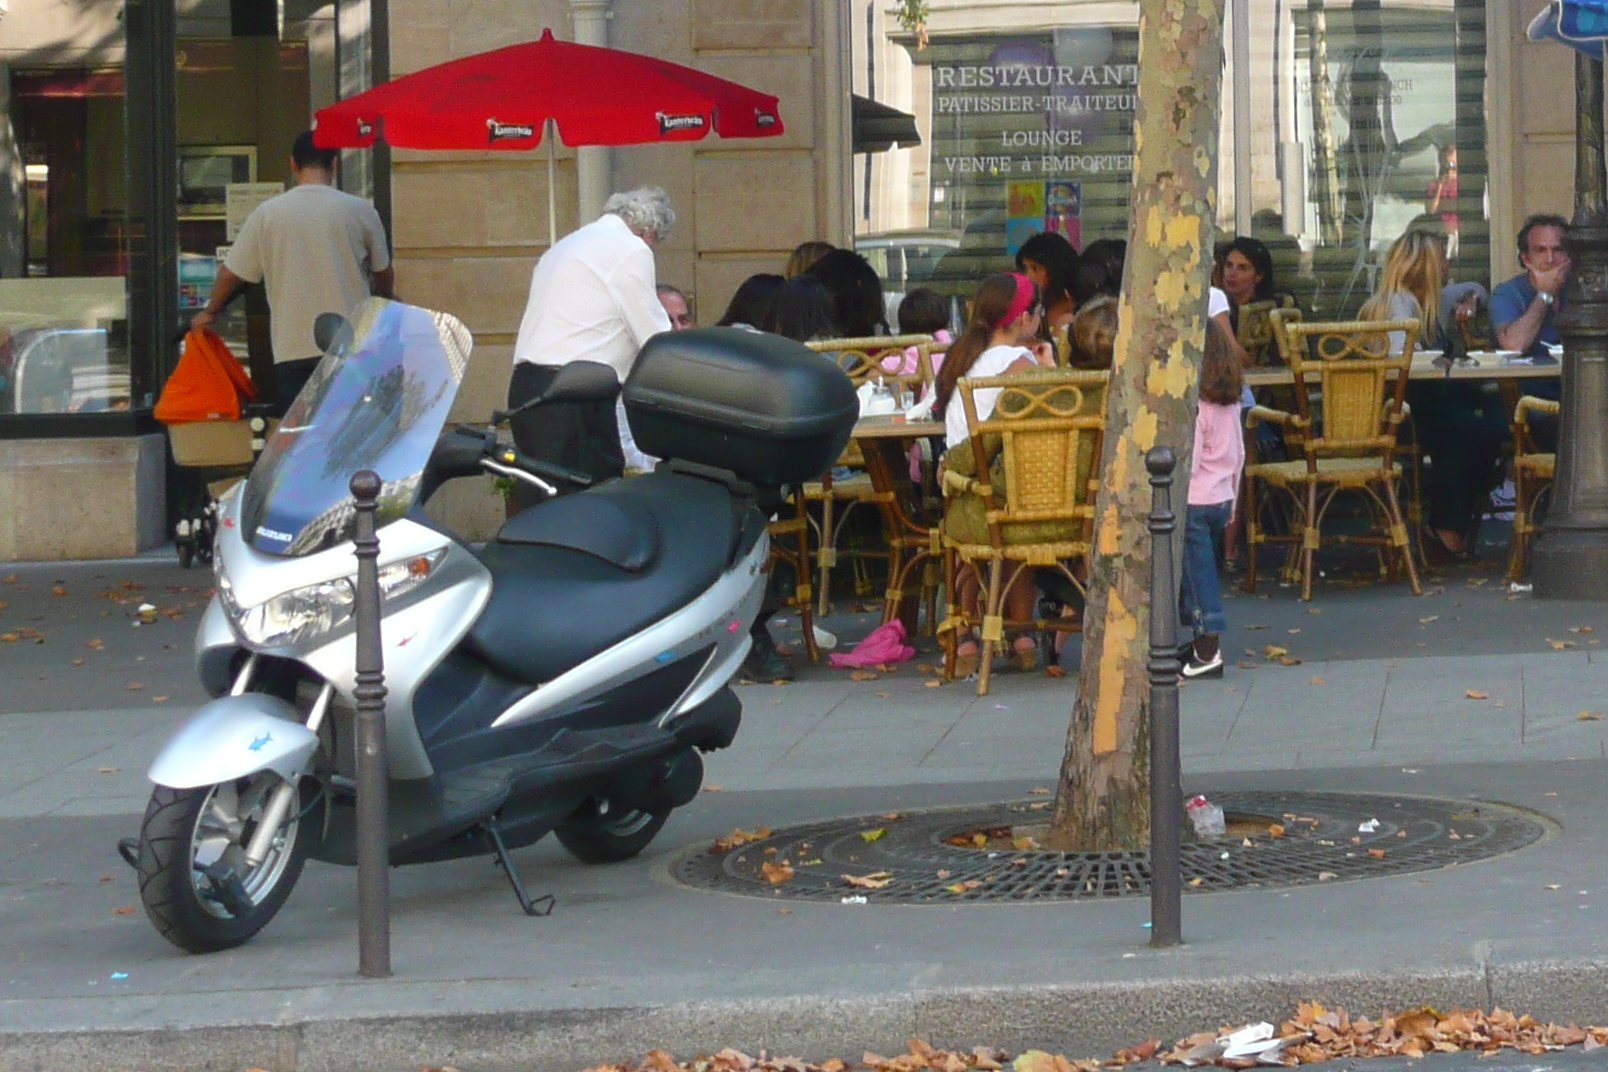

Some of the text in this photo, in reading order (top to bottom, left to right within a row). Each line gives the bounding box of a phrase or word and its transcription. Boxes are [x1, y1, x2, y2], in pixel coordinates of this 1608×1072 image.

[937, 64, 1140, 88] RESTAURANT
[1001, 130, 1083, 147] LOUNGE
[944, 156, 1012, 173] VENTE
[1021, 156, 1031, 172] à
